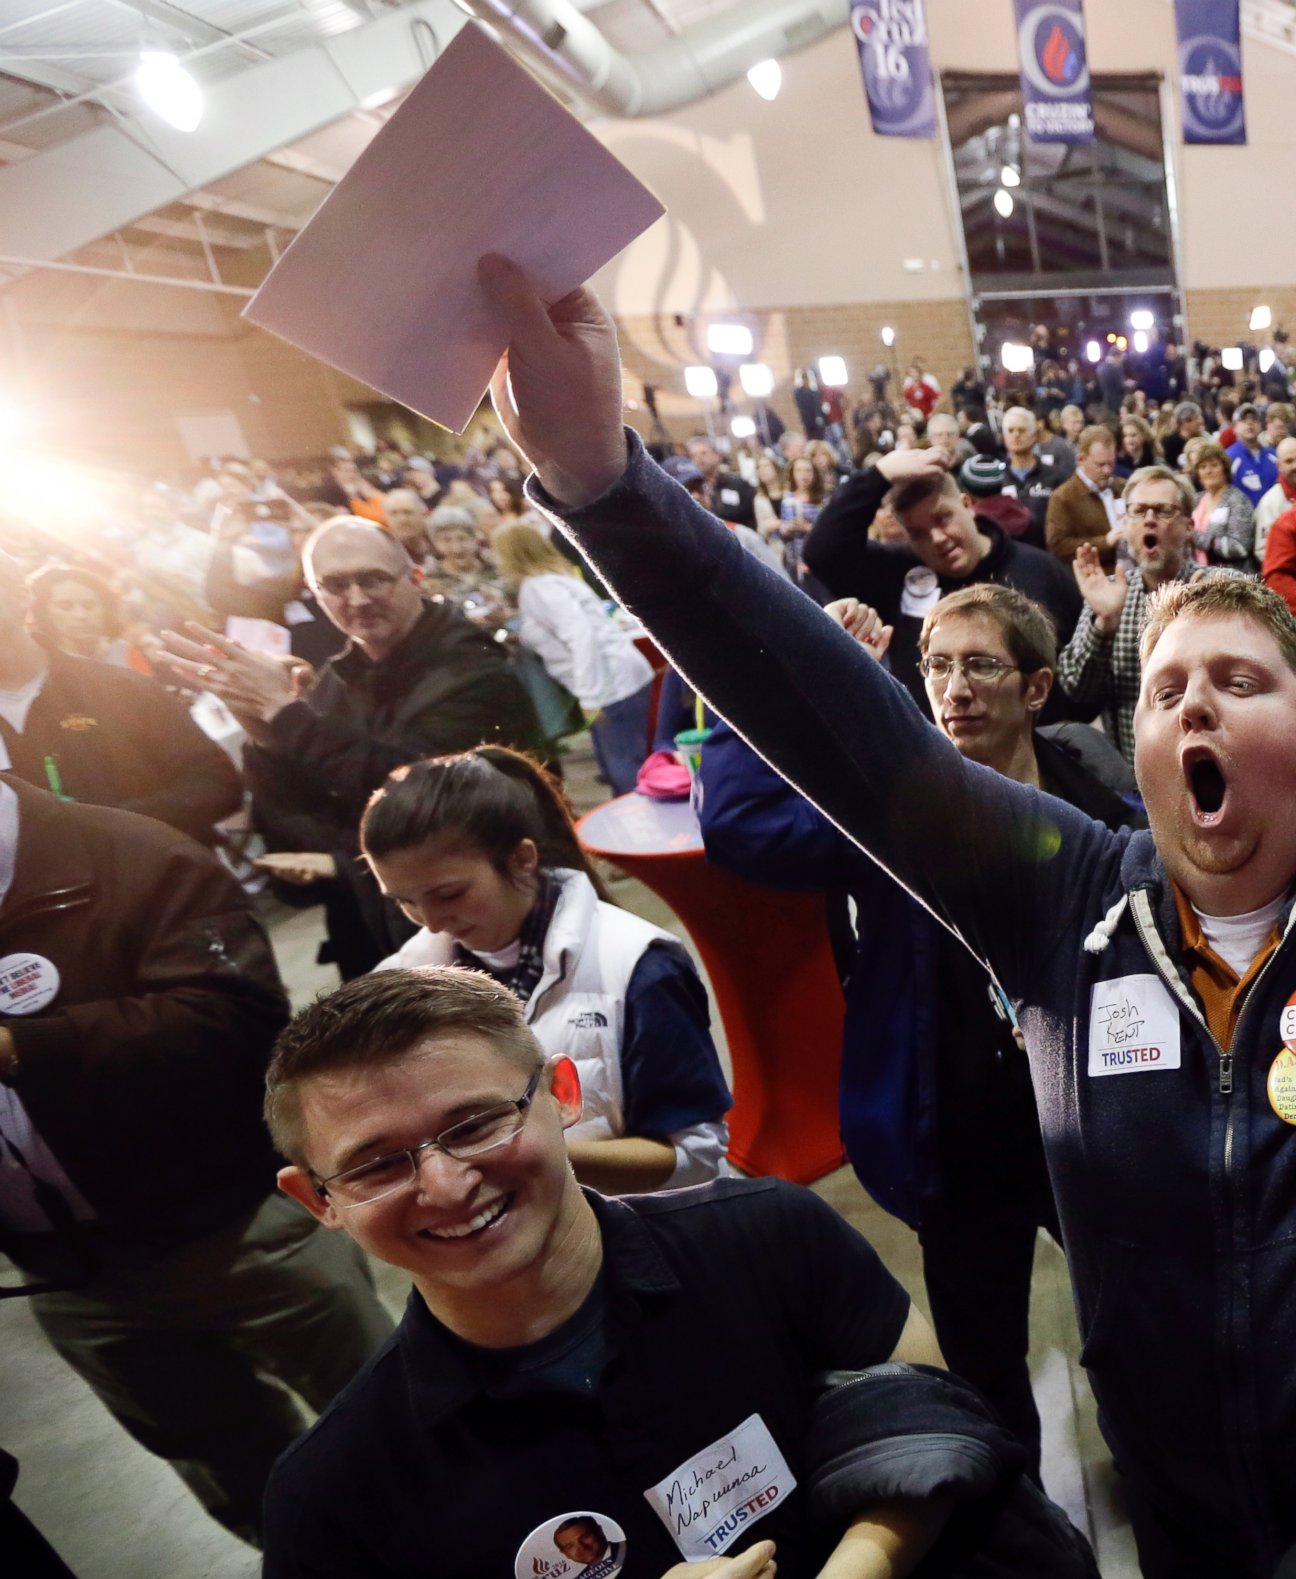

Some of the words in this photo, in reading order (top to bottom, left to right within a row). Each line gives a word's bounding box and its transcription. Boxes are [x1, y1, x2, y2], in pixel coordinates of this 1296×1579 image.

[874, 41, 910, 82] 16
[1097, 998, 1139, 1024] Josh
[1101, 1047, 1161, 1067] TRUSTED
[666, 1446, 737, 1517] Michael
[704, 1485, 779, 1549] TRUSTED
